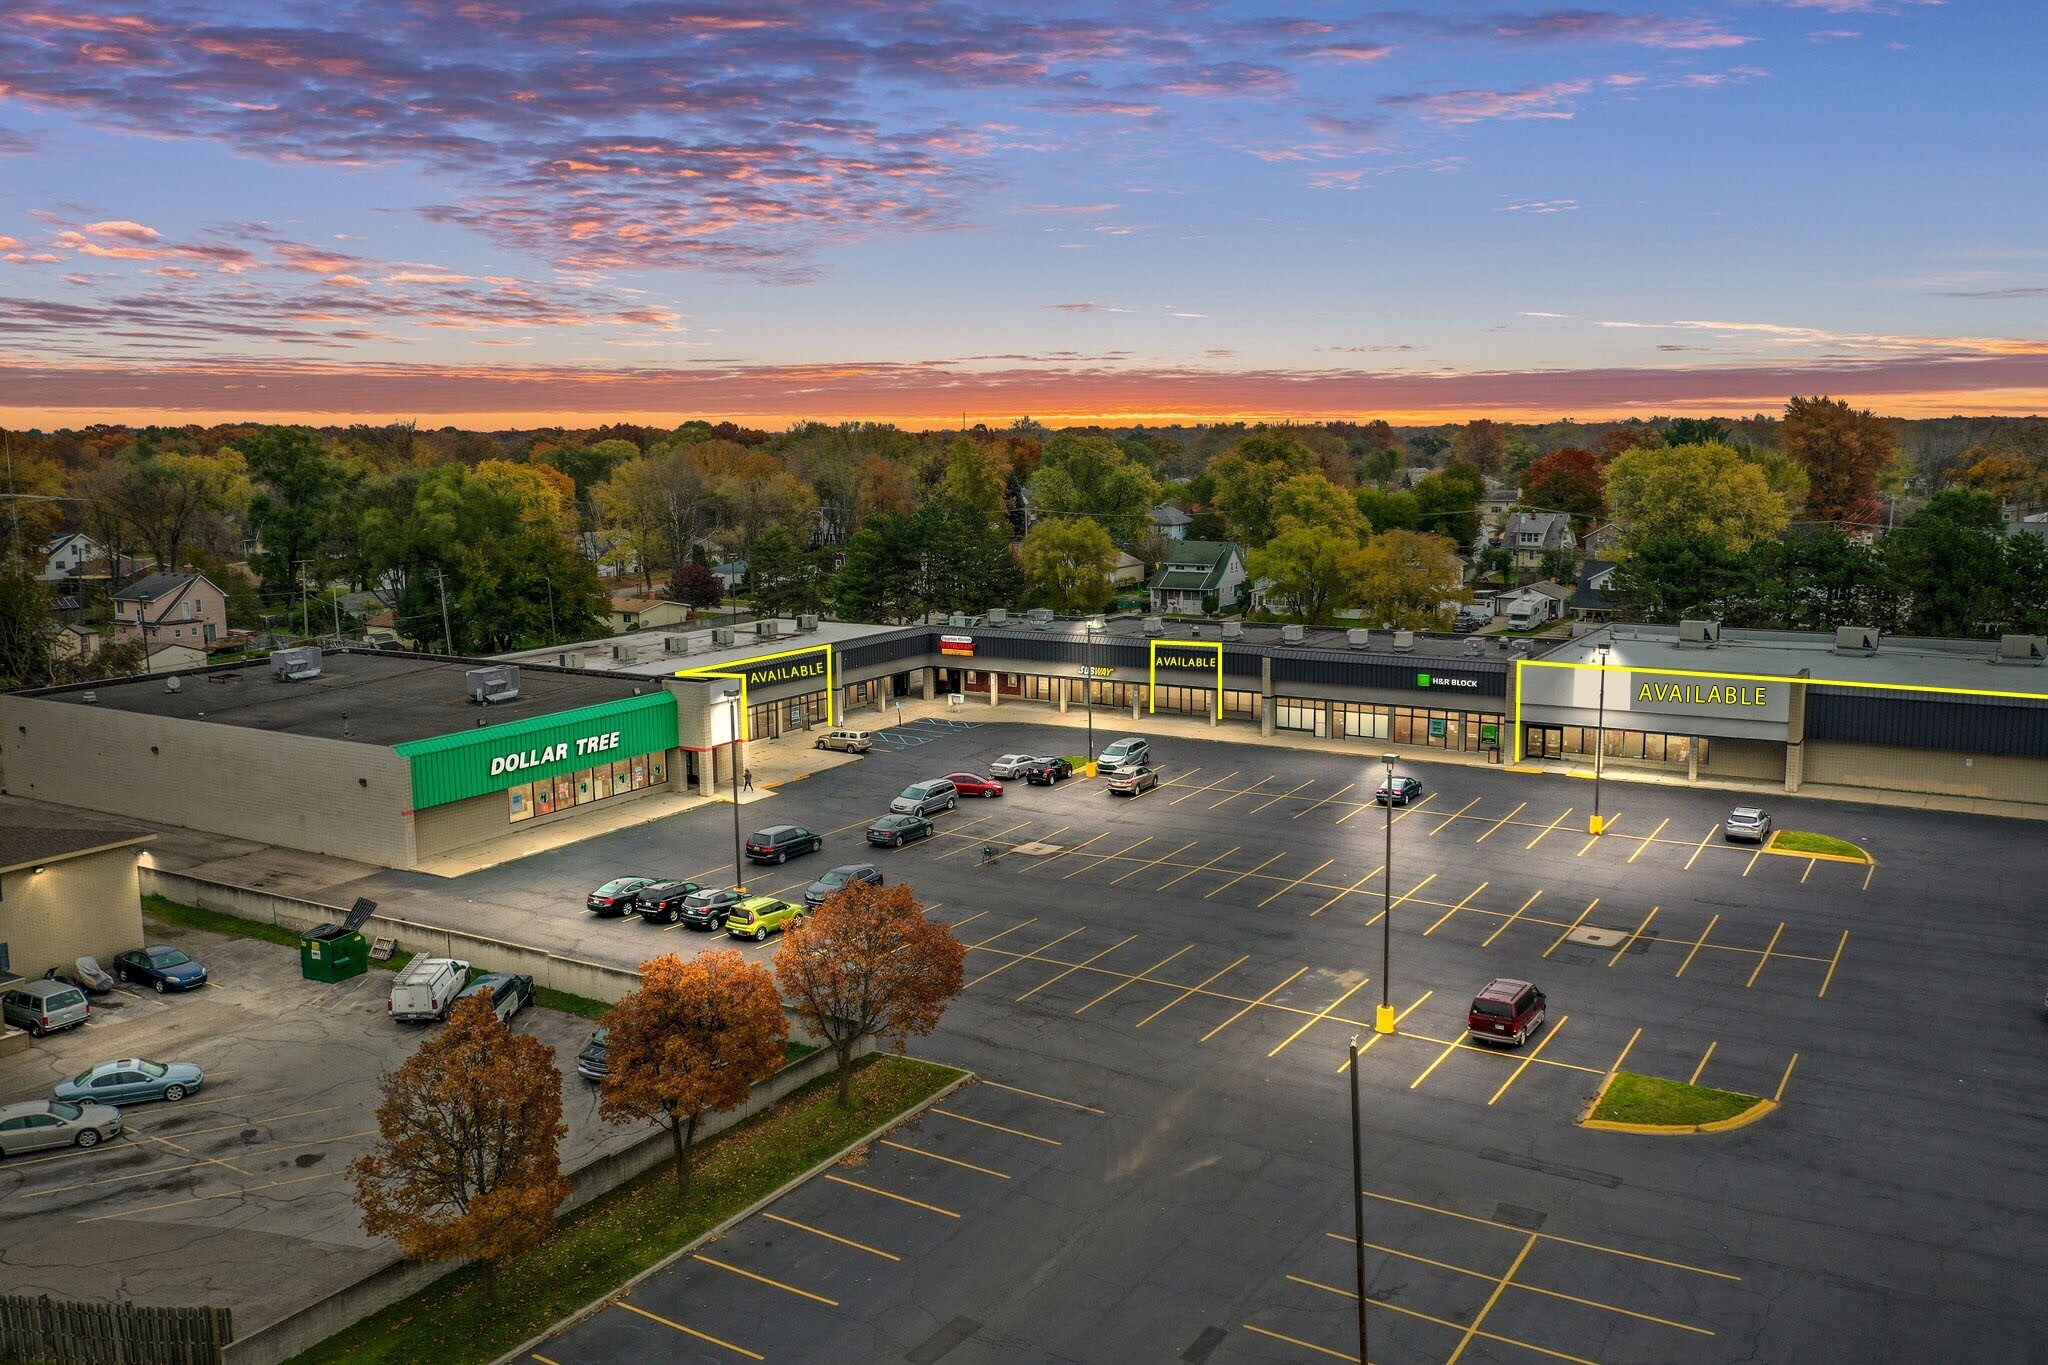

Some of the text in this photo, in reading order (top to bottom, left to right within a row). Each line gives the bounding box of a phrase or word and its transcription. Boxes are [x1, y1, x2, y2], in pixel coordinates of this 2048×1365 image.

[1078, 665, 1114, 677] SUBWAY
[1432, 677, 1478, 688] H&R BLOCK
[490, 731, 621, 776] DOLLAR TREE
